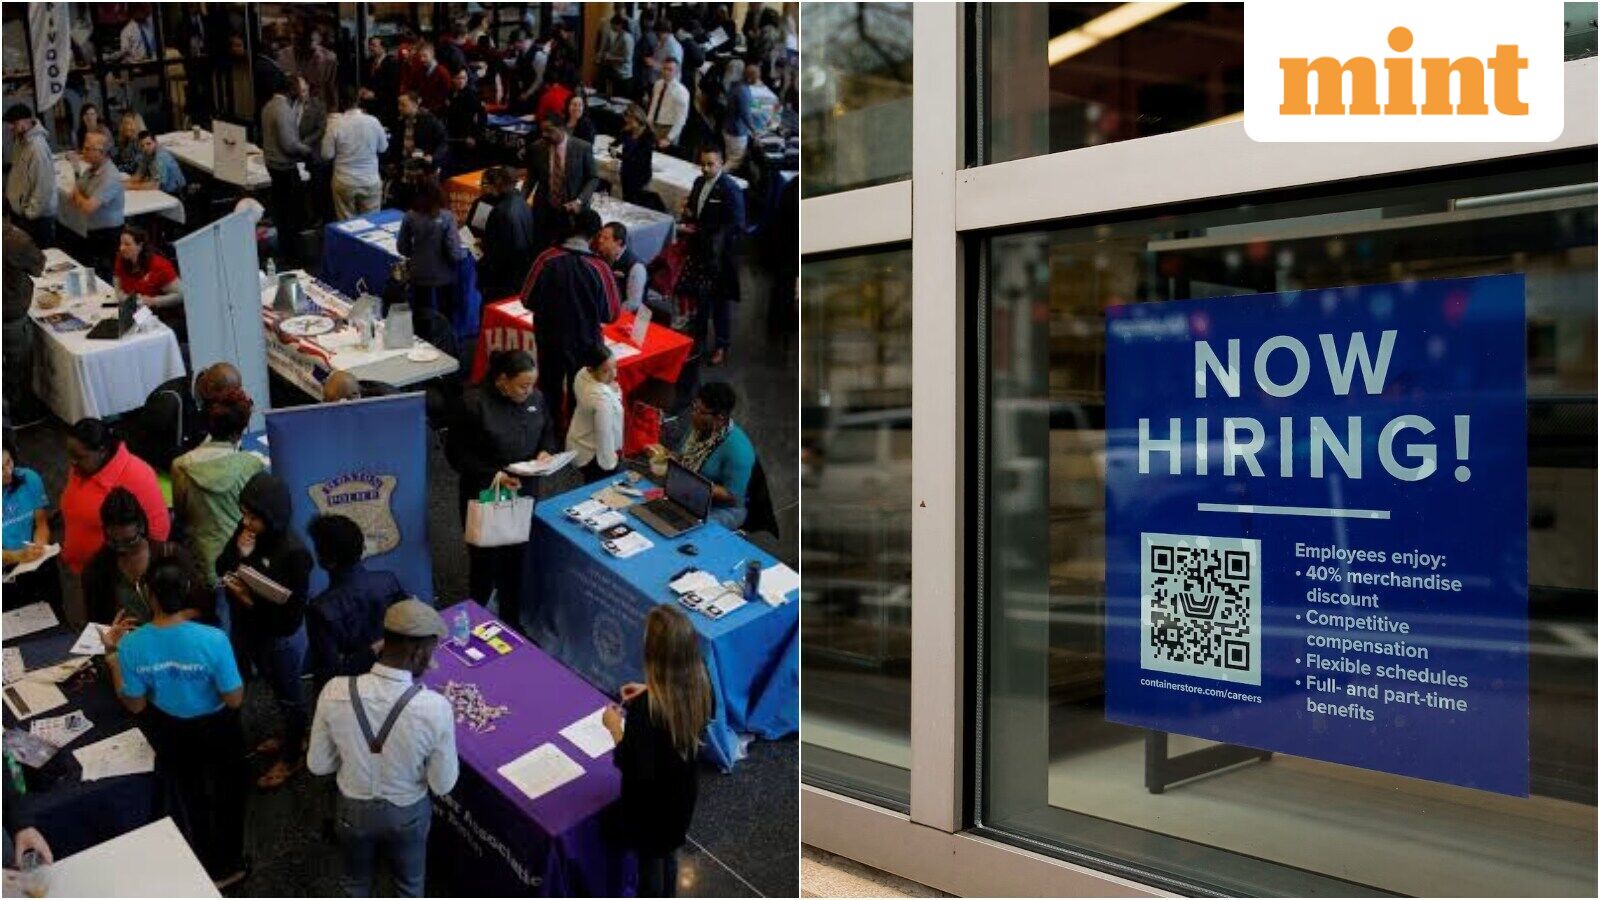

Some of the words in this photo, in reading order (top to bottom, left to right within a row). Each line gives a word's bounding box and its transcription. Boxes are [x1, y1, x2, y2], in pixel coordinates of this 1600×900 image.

[1195, 329, 1398, 398] NOW
[1138, 414, 1471, 482] HIRING!
[1295, 543, 1386, 563] Employees
[1391, 549, 1447, 570] enjoy:
[1306, 565, 1342, 582] 40%
[1347, 572, 1462, 592] merchandise
[1306, 588, 1379, 608] discount
[1306, 609, 1410, 634] Competitive
[1306, 633, 1429, 660] compensation
[1306, 653, 1371, 676] Flexible
[1376, 663, 1469, 688] schedules
[1140, 678, 1262, 703] containerstore.com/careers
[1306, 675, 1342, 694] Full-
[1347, 683, 1379, 700] and
[1384, 687, 1468, 712] part-time
[1306, 697, 1376, 722] benefits
